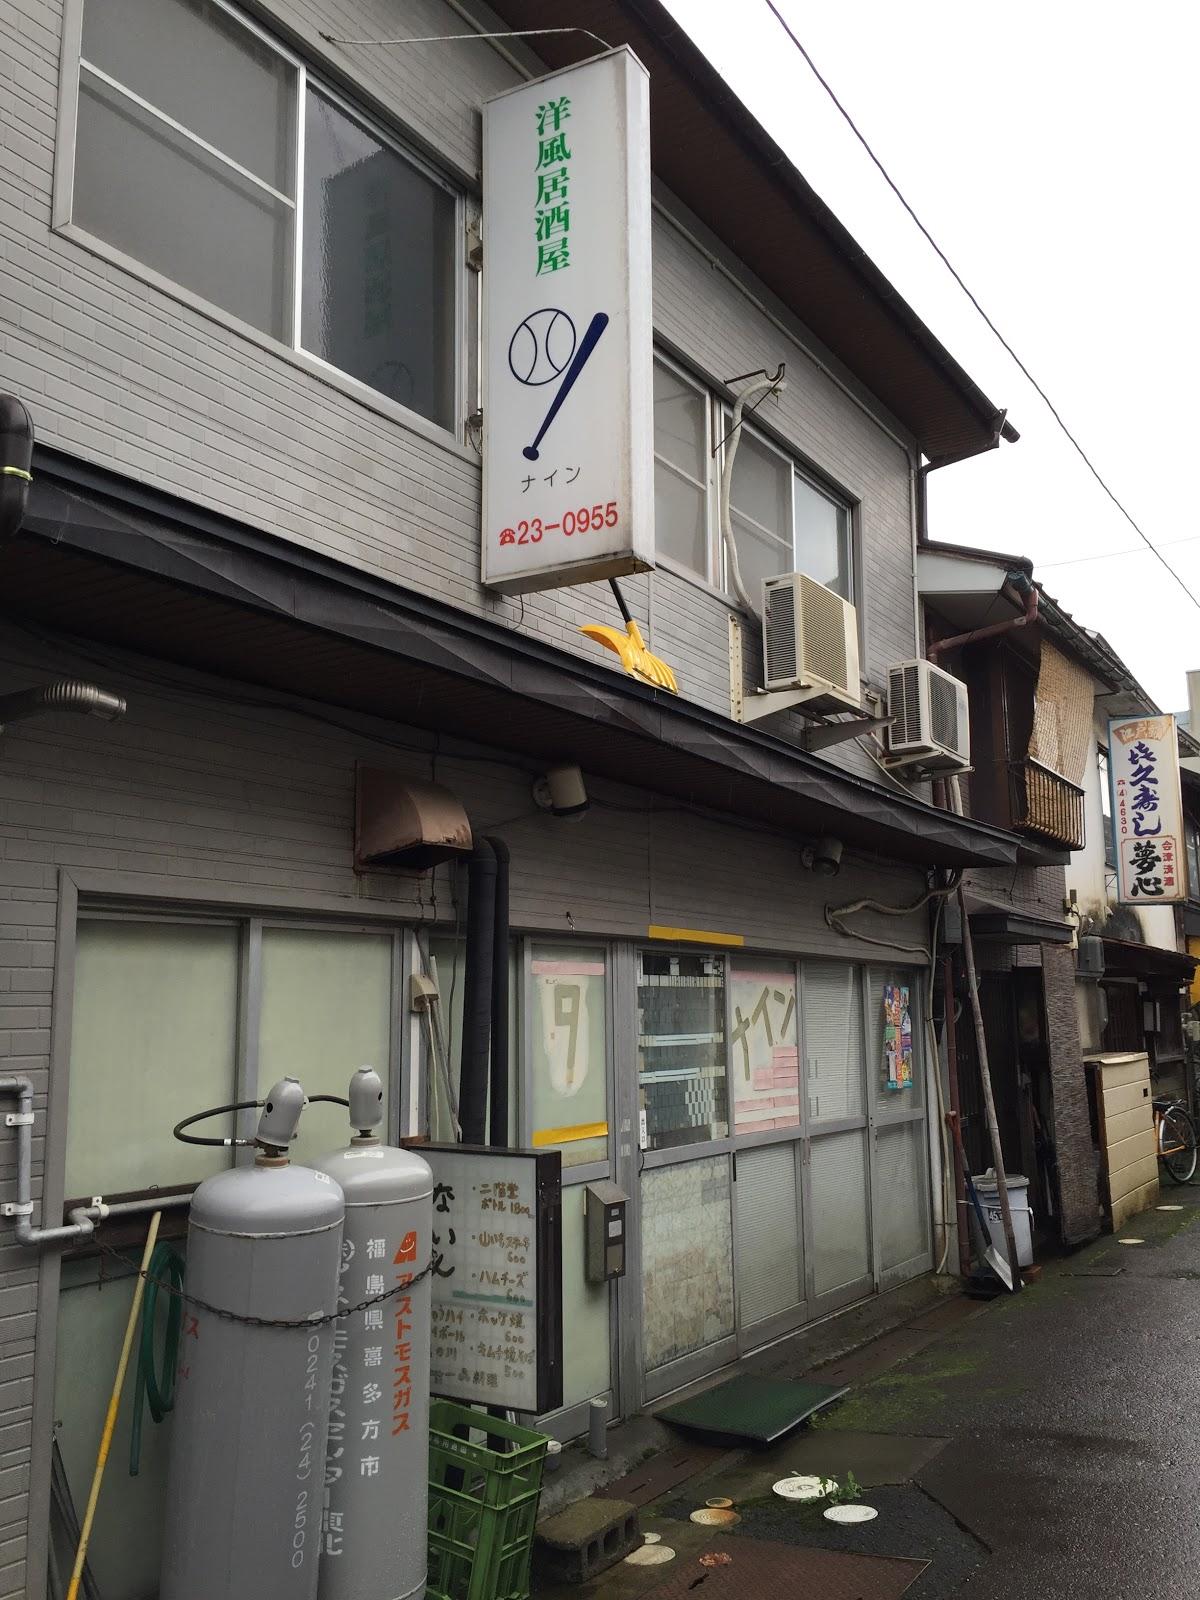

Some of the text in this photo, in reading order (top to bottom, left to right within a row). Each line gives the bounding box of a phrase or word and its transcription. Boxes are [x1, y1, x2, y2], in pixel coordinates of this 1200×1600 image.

[535, 97, 572, 276] 洋風居酒屋
[520, 465, 582, 494] ナイン
[517, 502, 619, 546] 23-0955
[1129, 840, 1165, 897] 夢心
[731, 985, 797, 1082] ナイン
[480, 1270, 529, 1289] ハムチーズ
[360, 1238, 387, 1478] 福島県喜多方市
[391, 1272, 414, 1437] アストモスガス
